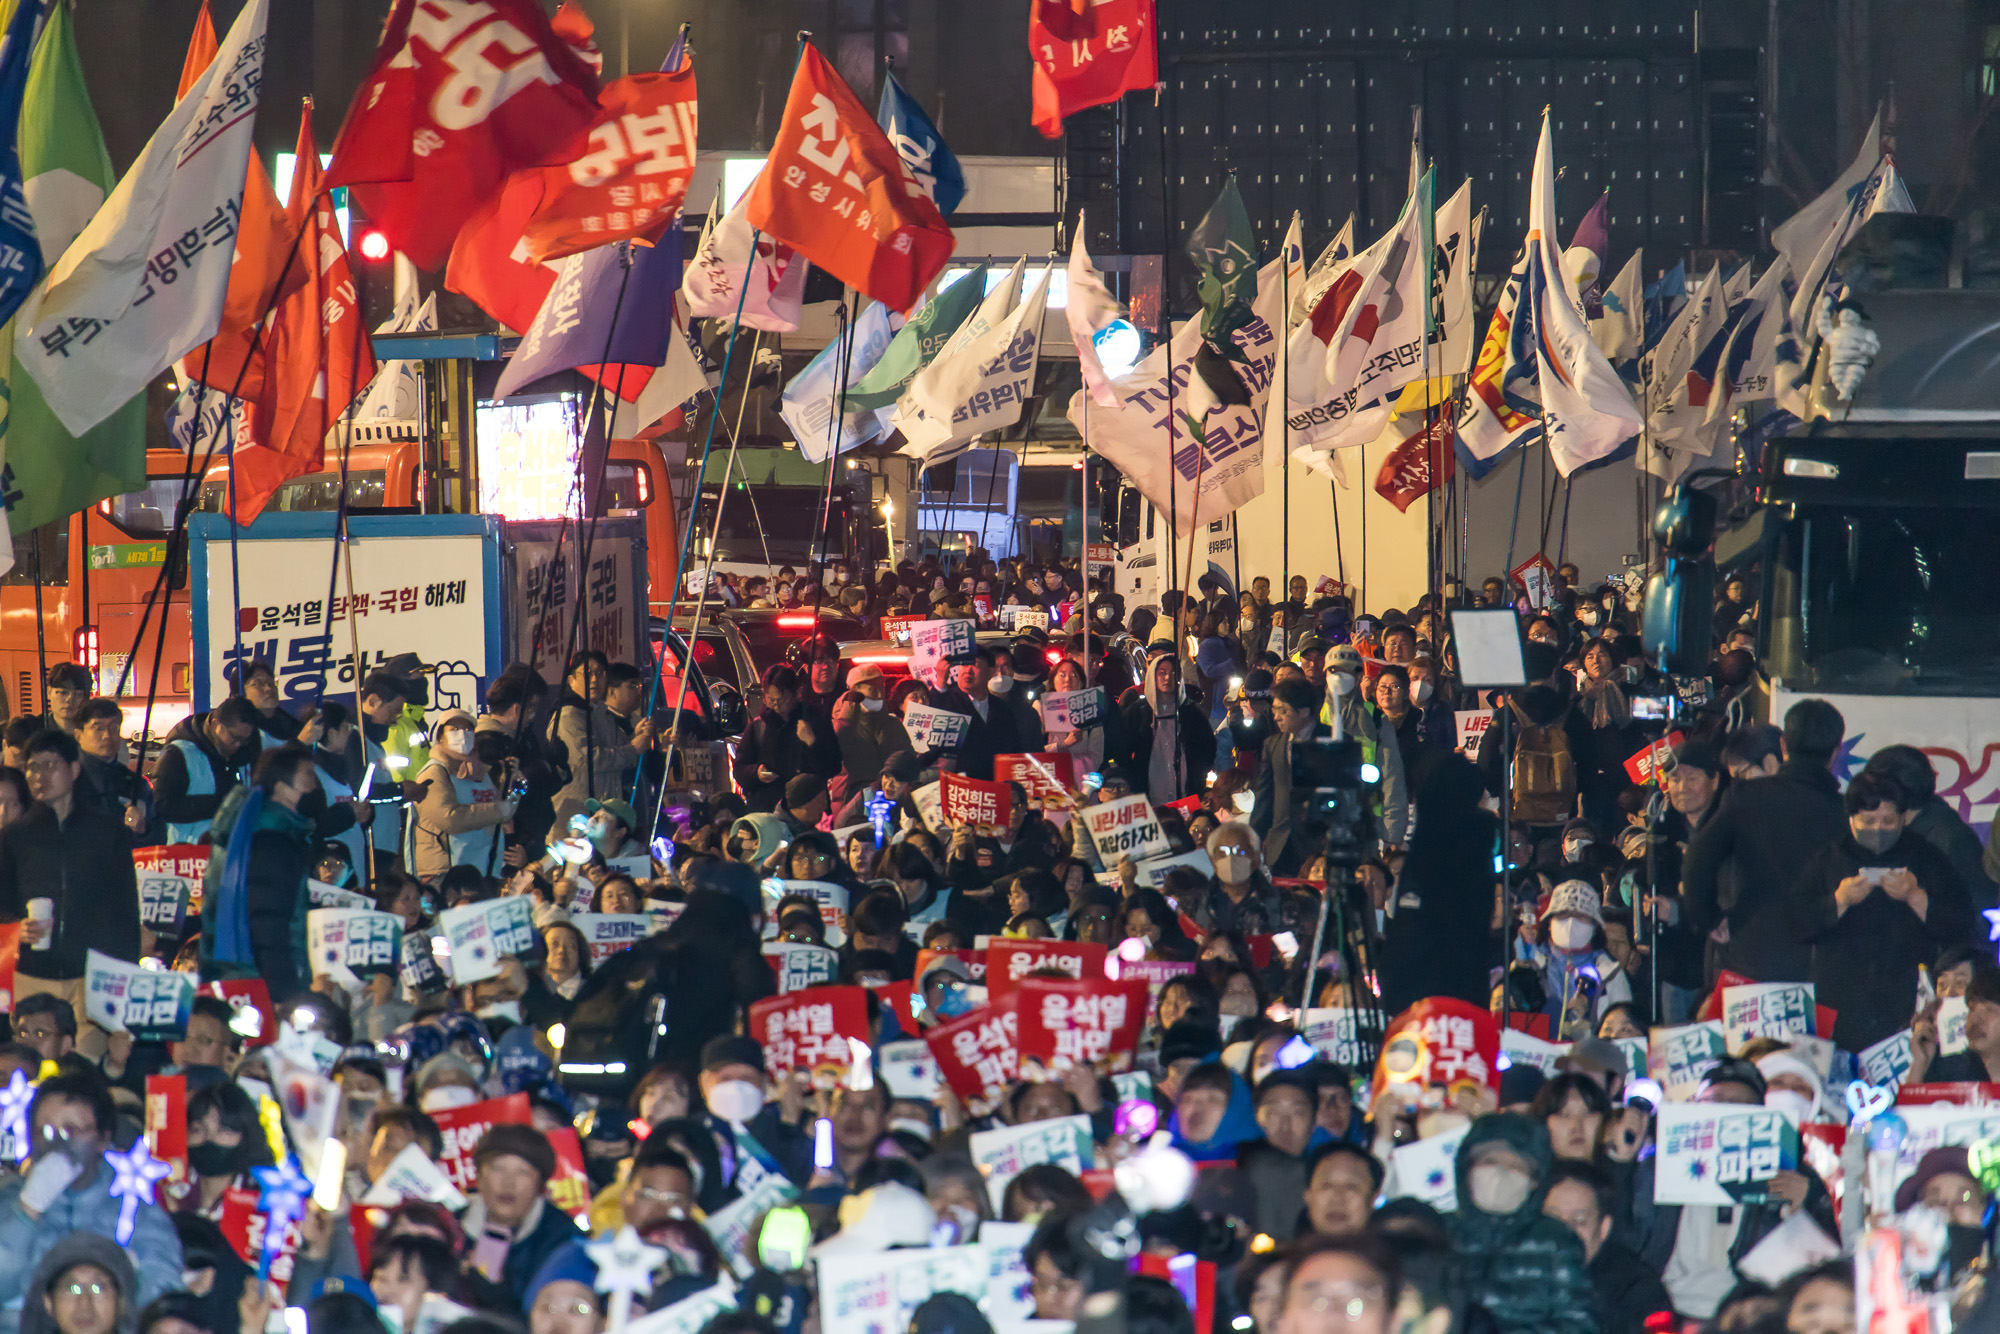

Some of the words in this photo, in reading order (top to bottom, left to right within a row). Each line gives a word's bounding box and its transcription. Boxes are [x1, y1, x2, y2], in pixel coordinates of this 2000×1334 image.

[260, 599, 323, 631] 윤석열
[425, 579, 467, 607] 해체
[940, 621, 970, 640] 즉각
[940, 639, 970, 657] 파면
[932, 715, 965, 731] 즉각
[1069, 706, 1099, 725] 하라
[928, 731, 960, 747] 파면
[1011, 762, 1056, 779] 윤석열
[947, 783, 997, 807] 김건희도
[947, 800, 998, 824] 구속하라
[142, 878, 184, 901] 즉각
[141, 901, 178, 925] 파면
[487, 897, 532, 933] 즉각
[348, 916, 393, 941] 즉각
[347, 940, 392, 965] 파면
[493, 926, 535, 960] 파면
[788, 950, 829, 971] 즉각
[129, 974, 184, 1002] 즉각
[125, 1001, 179, 1026] 파면
[1041, 993, 1128, 1030] 윤석열
[1763, 987, 1805, 1021] 즉각
[766, 1002, 834, 1042] 윤석열
[798, 1032, 850, 1065] 구속
[1053, 1028, 1113, 1062] 파면
[1667, 1027, 1711, 1066] 즉각
[1435, 1048, 1488, 1085] 구속
[1719, 1110, 1783, 1148] 즉각
[1718, 1147, 1781, 1186] 파면
